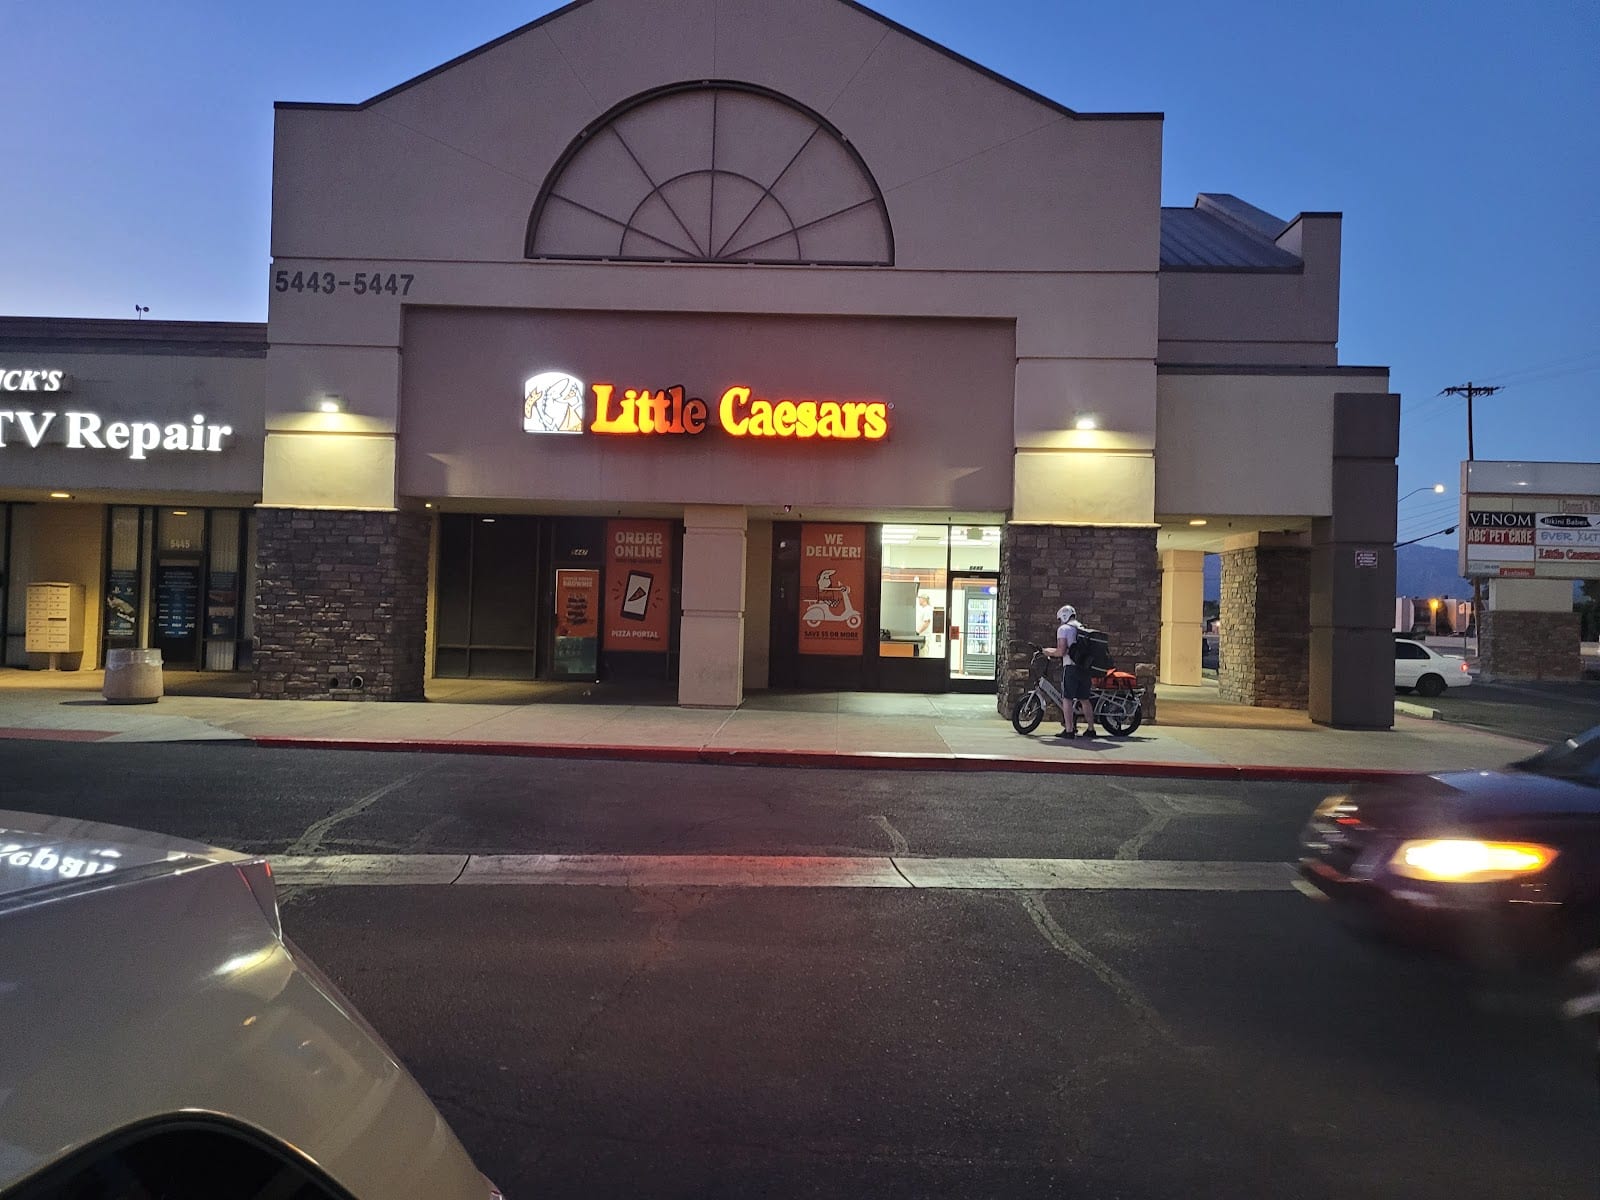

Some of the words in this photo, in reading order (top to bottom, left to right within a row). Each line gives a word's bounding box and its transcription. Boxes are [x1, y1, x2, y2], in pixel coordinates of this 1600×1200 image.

[275, 271, 414, 296] 5443-5447
[591, 384, 707, 435] Little
[719, 386, 888, 439] Caesars
[66, 411, 232, 459] Repair
[1470, 513, 1531, 526] VENOM
[615, 531, 663, 545] ORDER
[824, 533, 844, 545] WE
[1468, 529, 1486, 543] ABC
[1490, 529, 1506, 543] PET
[1509, 529, 1532, 544] CARE
[614, 545, 663, 558] ONLINE
[806, 545, 862, 558] DELIVER!
[632, 630, 659, 638] PORTAL
